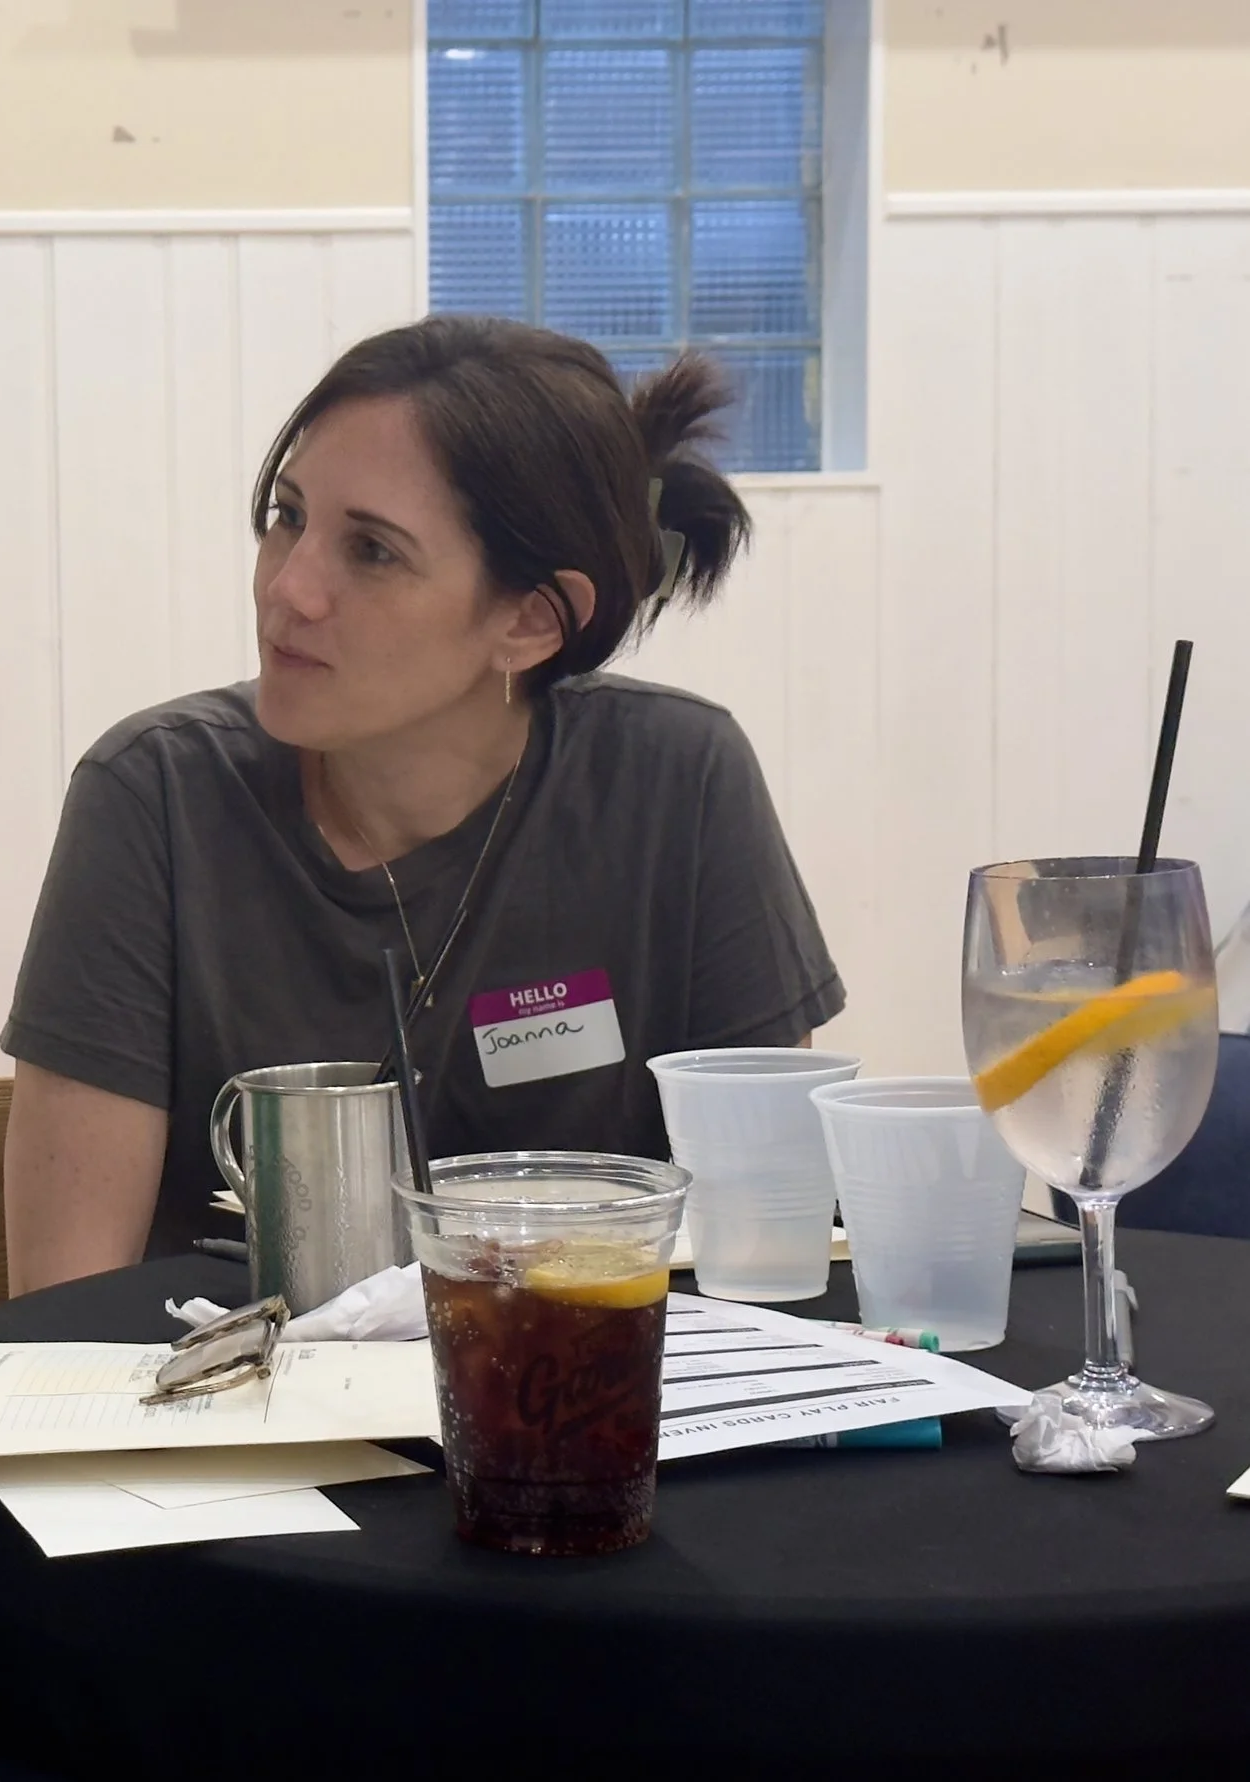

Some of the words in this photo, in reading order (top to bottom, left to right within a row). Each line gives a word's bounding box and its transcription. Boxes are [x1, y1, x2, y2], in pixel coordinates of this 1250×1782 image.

[509, 982, 567, 1007] HELLO
[482, 1021, 585, 1055] Joanna
[854, 1396, 900, 1408] FAIR
[799, 1404, 849, 1417] PLAY
[722, 1413, 792, 1427] CARDS
